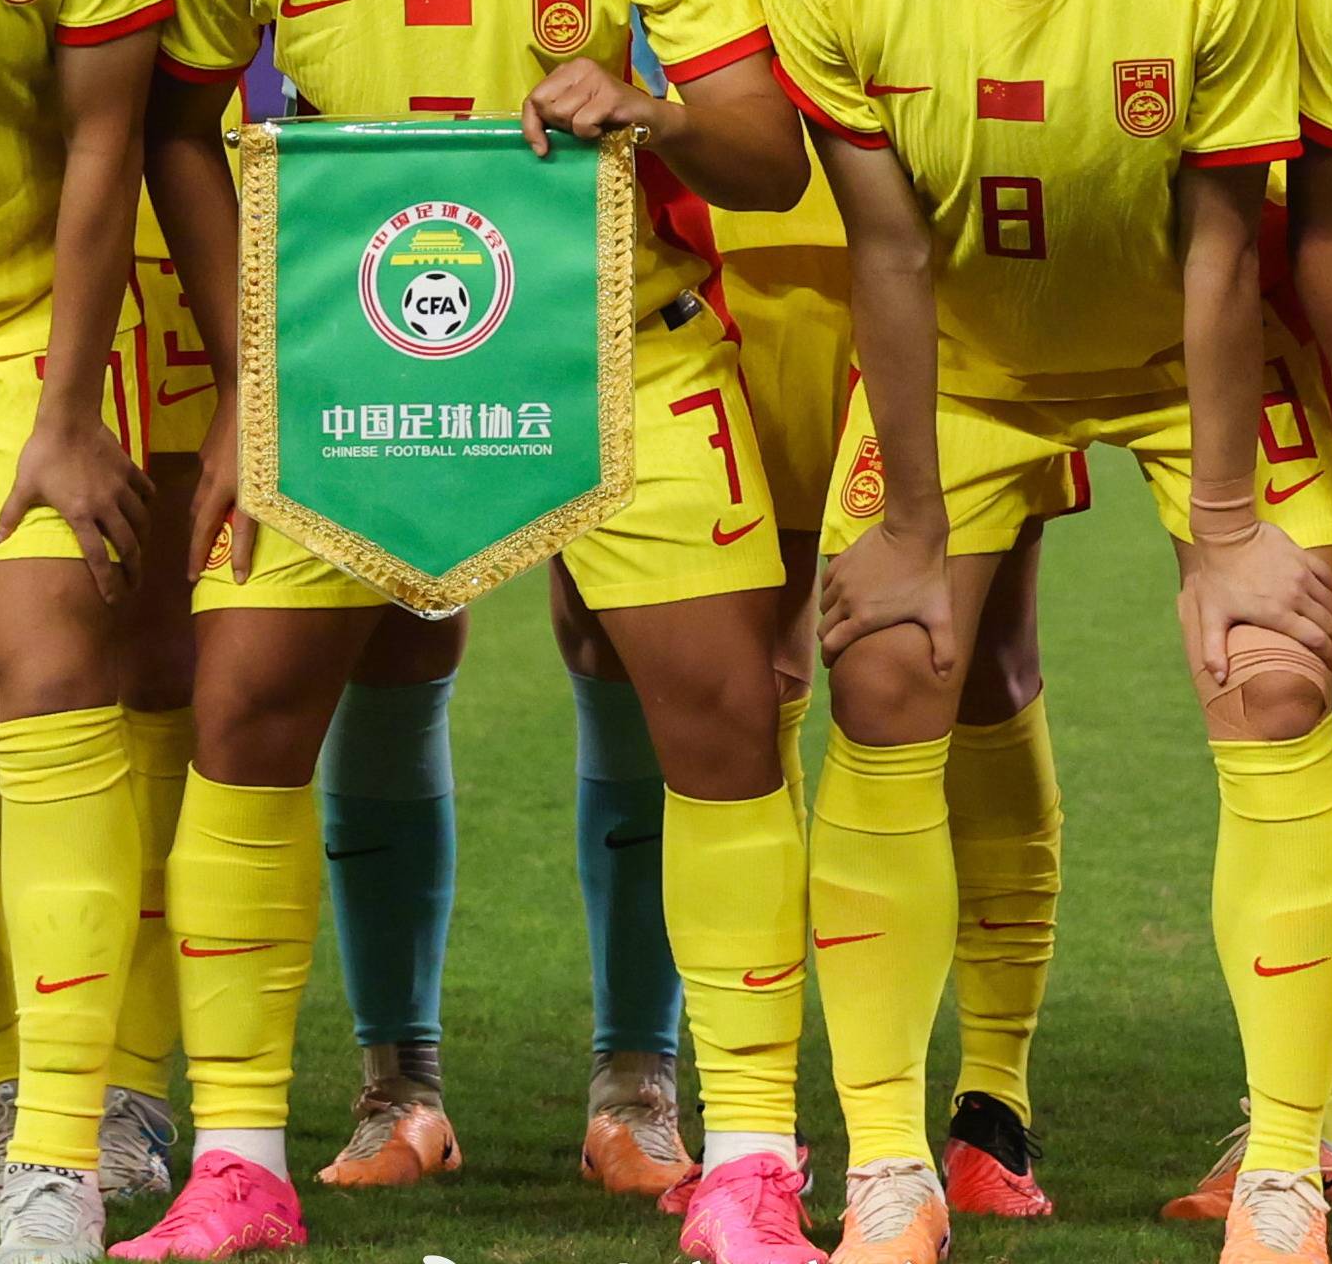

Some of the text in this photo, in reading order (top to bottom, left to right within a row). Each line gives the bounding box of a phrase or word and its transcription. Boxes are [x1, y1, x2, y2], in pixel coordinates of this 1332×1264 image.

[1121, 66, 1167, 81] CFA
[371, 203, 503, 250] 中国足球协会
[980, 176, 1047, 260] 8
[416, 296, 457, 315] CFA
[322, 402, 553, 441] 中国足球协会
[322, 443, 553, 458] CHINESE FOOTBALL ASSOCIATION
[669, 388, 743, 505] 7
